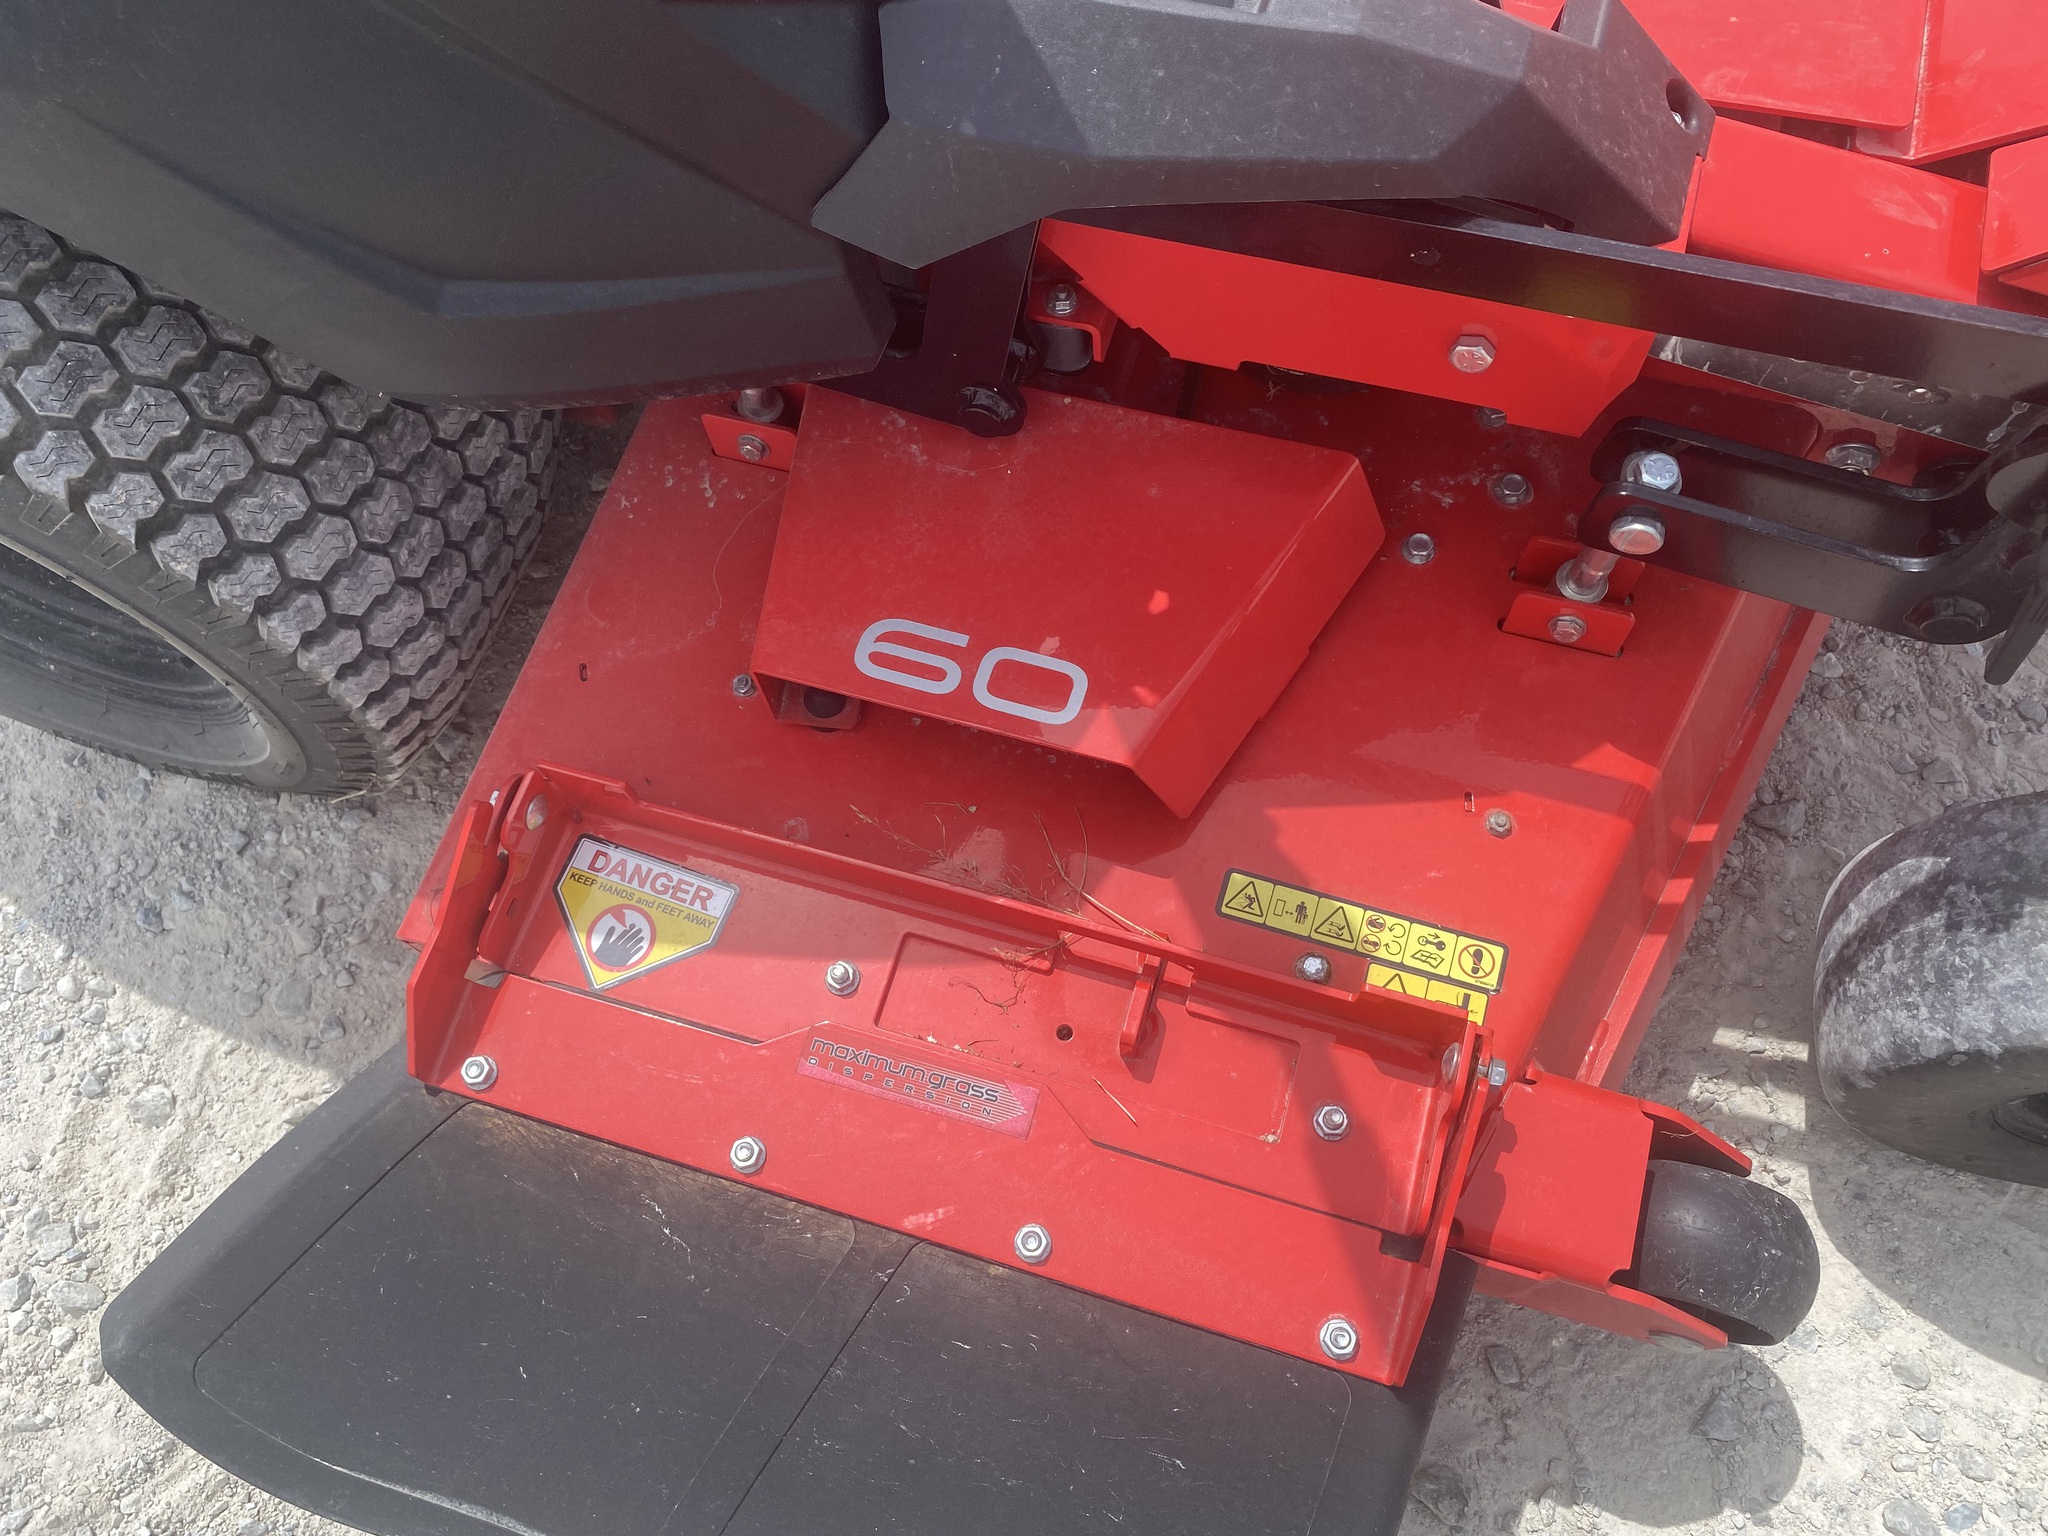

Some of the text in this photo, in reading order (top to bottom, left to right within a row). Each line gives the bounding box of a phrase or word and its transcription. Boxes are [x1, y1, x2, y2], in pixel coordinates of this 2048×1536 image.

[854, 618, 1088, 725] 60
[570, 872, 715, 930] KEEP HANDS and FEET AWAY
[587, 849, 714, 912] DANGER
[808, 1056, 993, 1117] DISPERSION
